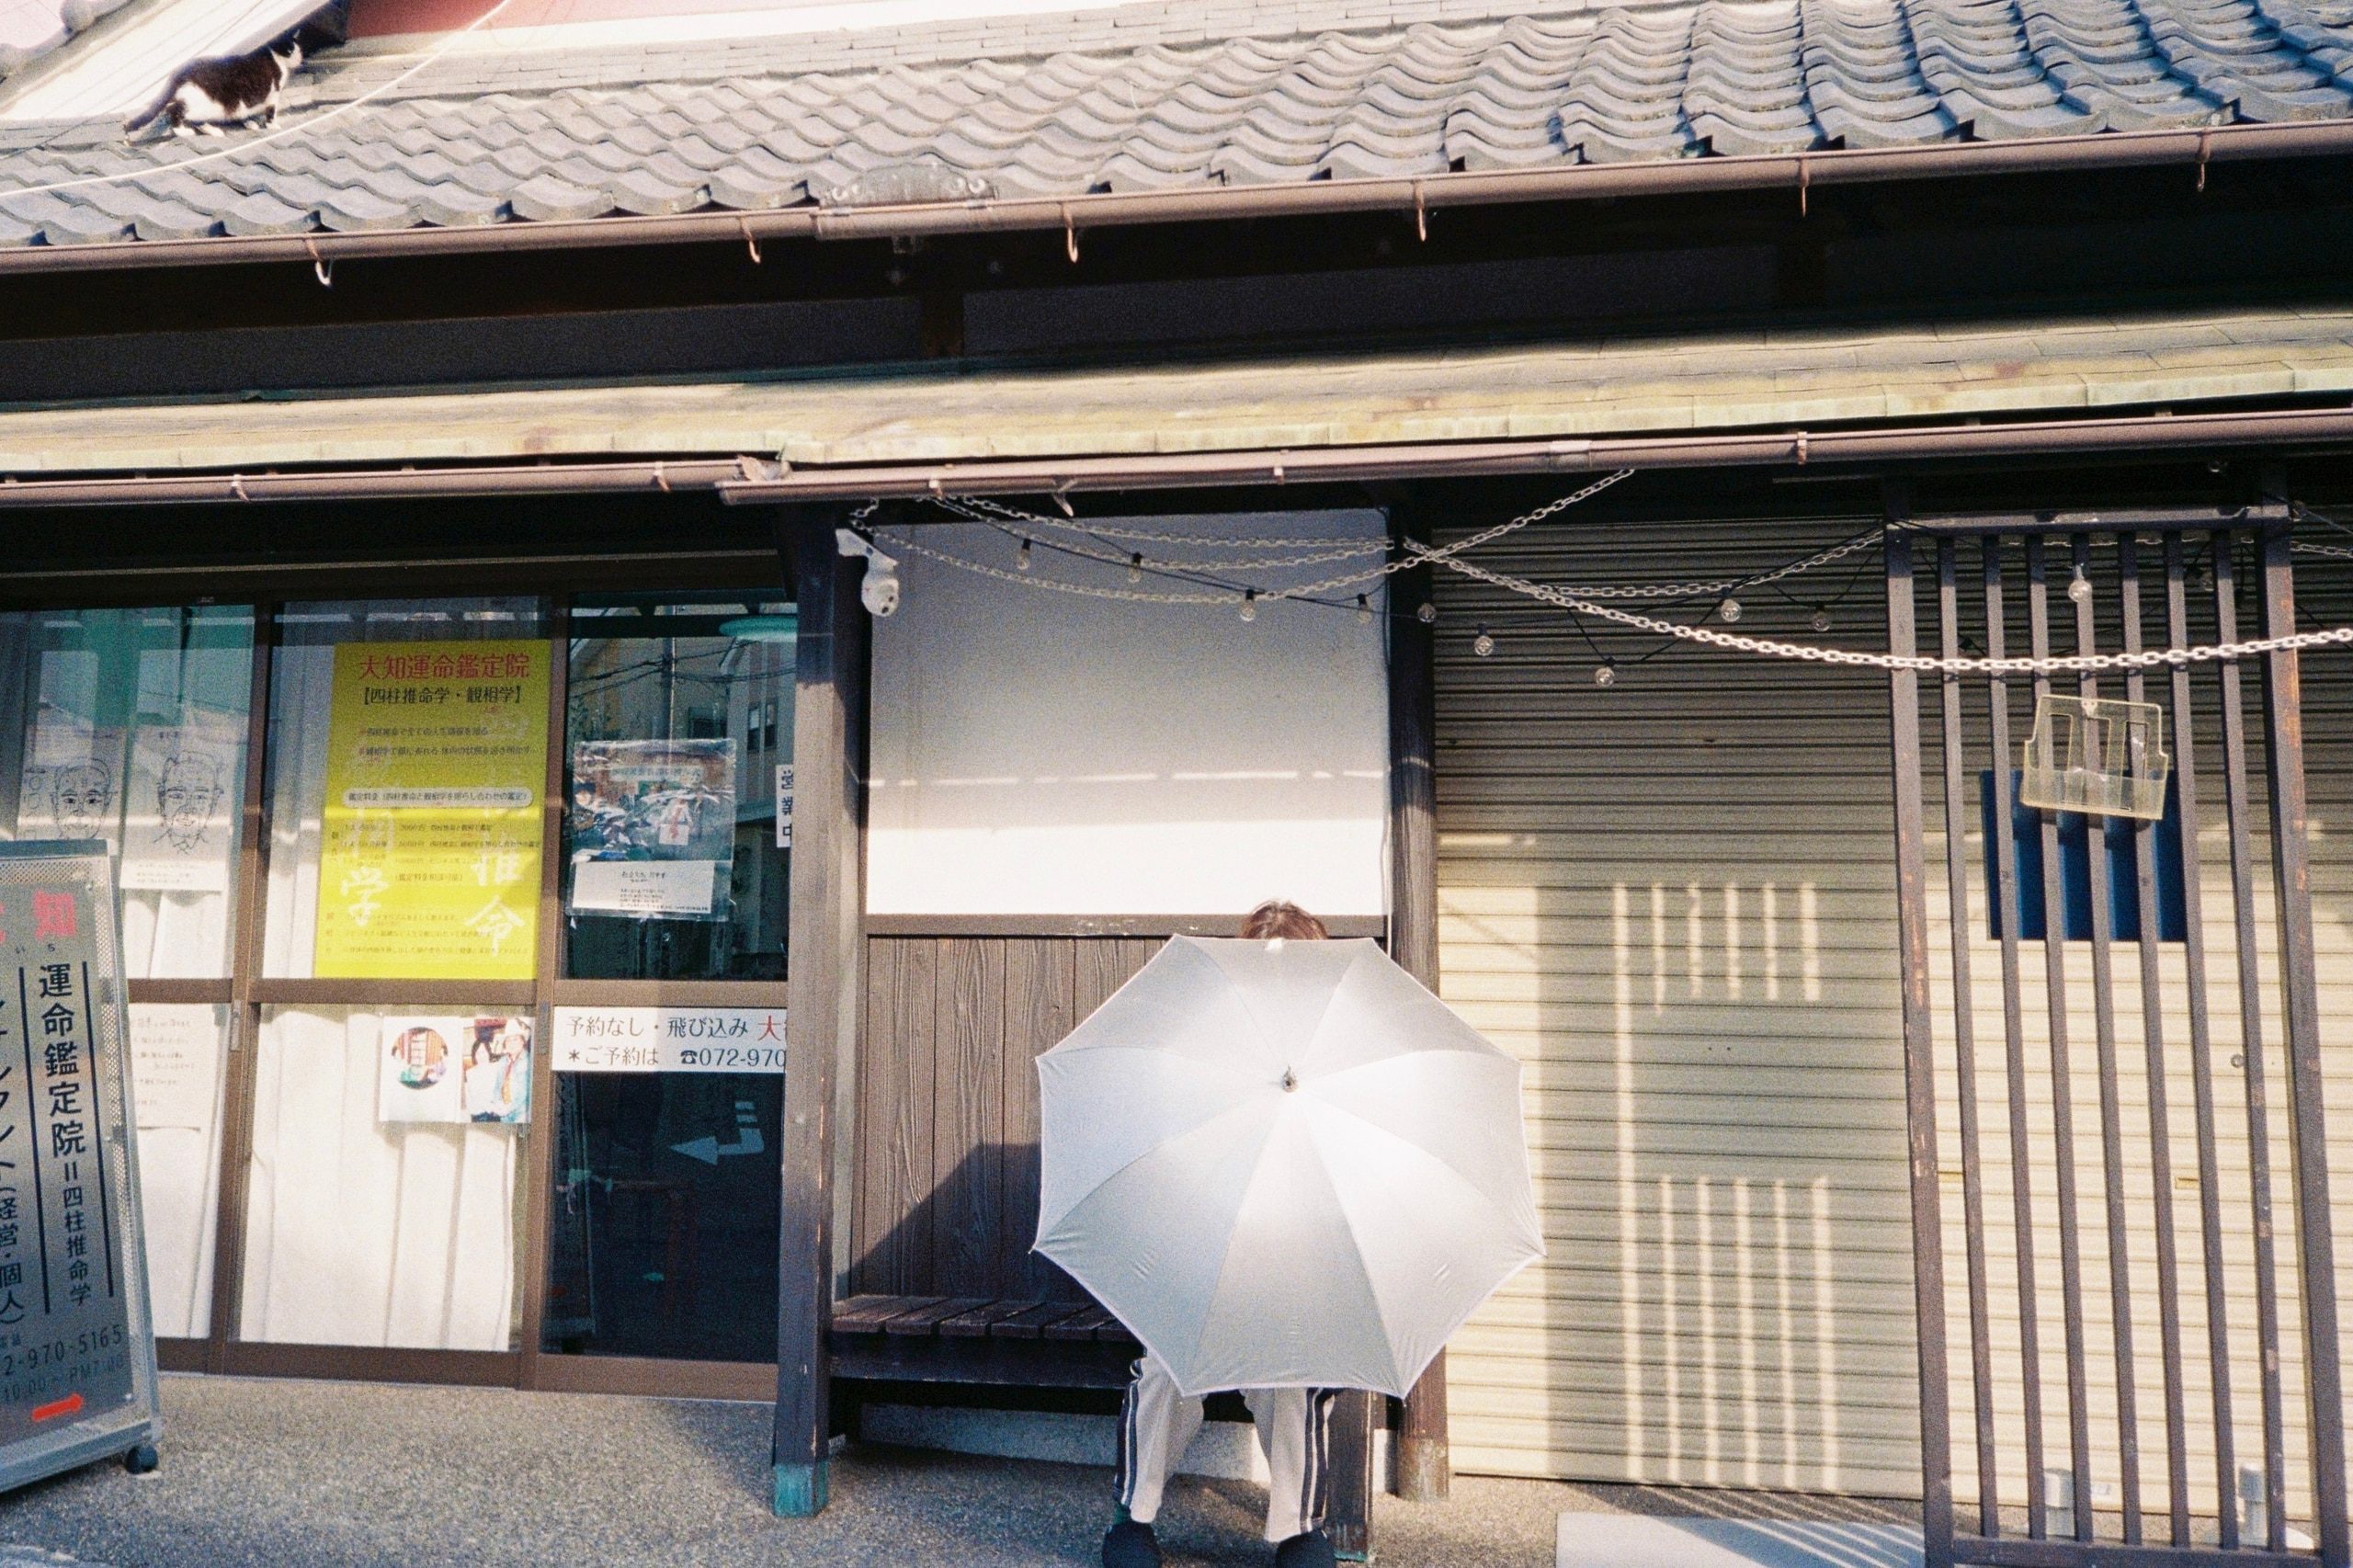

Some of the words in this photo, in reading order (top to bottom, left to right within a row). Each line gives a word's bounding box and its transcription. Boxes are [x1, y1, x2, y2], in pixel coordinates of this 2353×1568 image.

[358, 653, 530, 681] 大知運命鑑定院
[364, 686, 522, 706] 【四柱推命学・観相学】
[566, 1016, 749, 1040] 予約なし・飛び込み
[757, 1015, 787, 1041] 大
